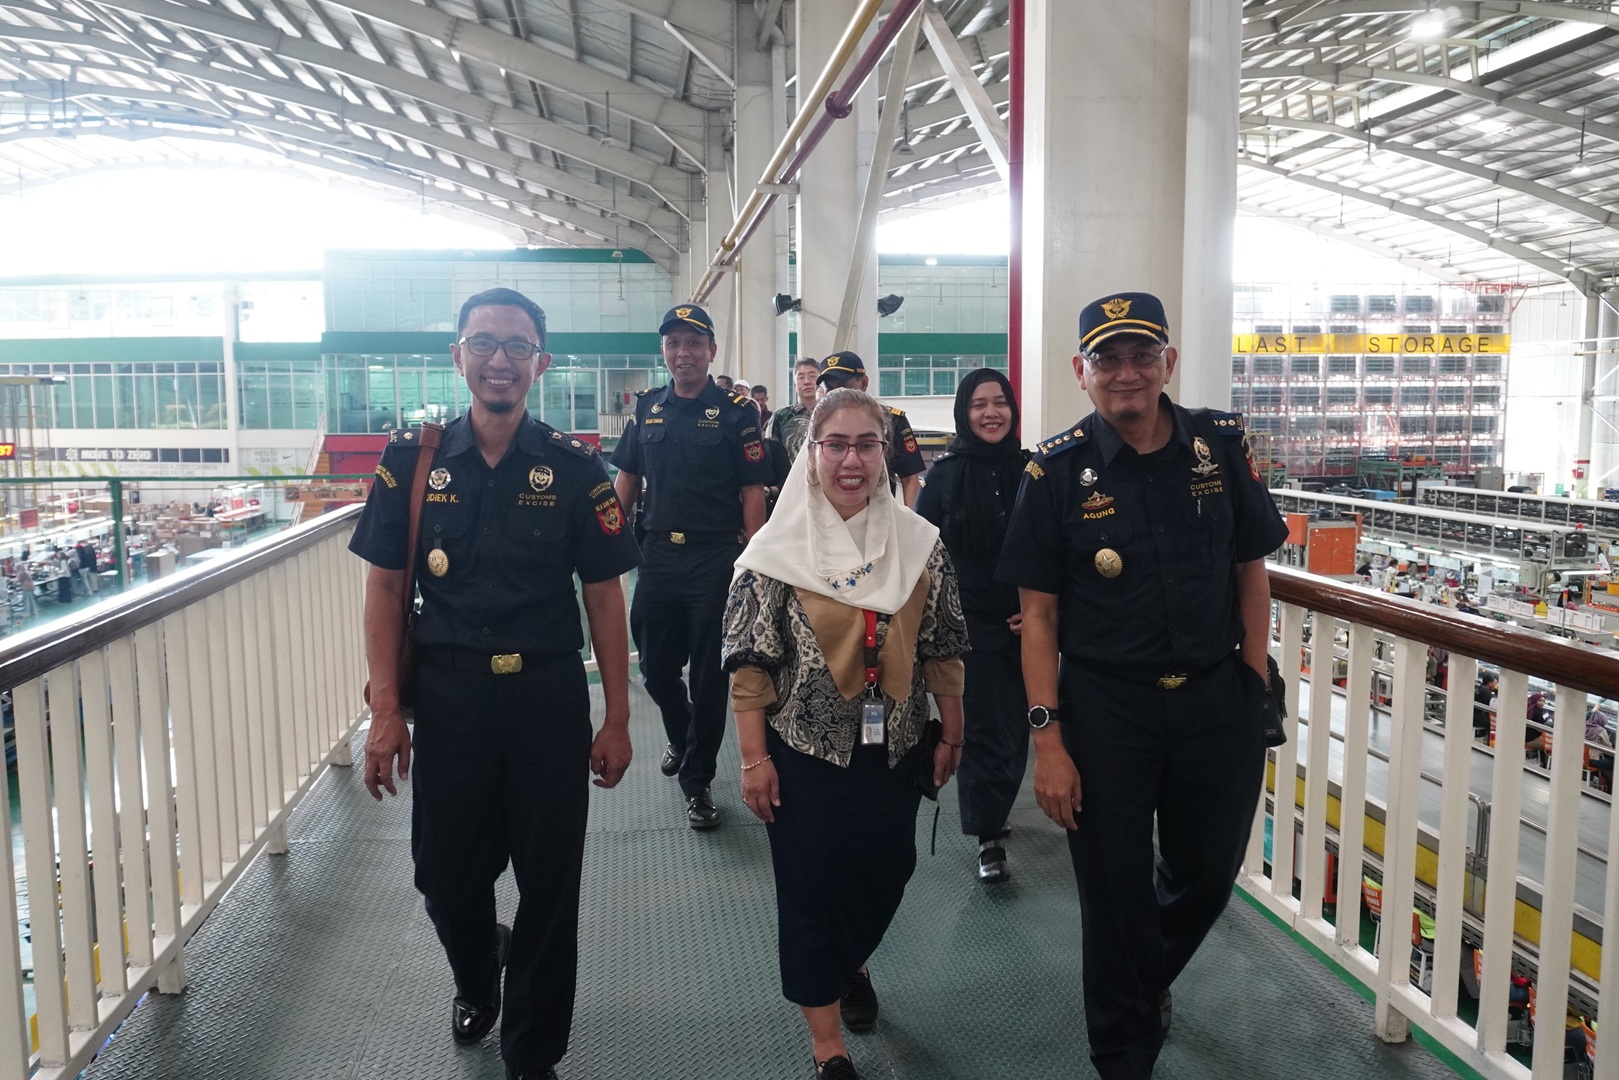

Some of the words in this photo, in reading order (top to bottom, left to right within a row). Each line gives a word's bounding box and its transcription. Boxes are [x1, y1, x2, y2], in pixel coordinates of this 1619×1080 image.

[1238, 336, 1306, 353] LAST
[1368, 336, 1489, 353] STORAGE
[81, 450, 108, 460] MOVE
[111, 450, 124, 460] TO
[127, 450, 151, 460] ZERO
[1191, 486, 1223, 497] EXCISE
[1083, 507, 1115, 519] AGUNG
